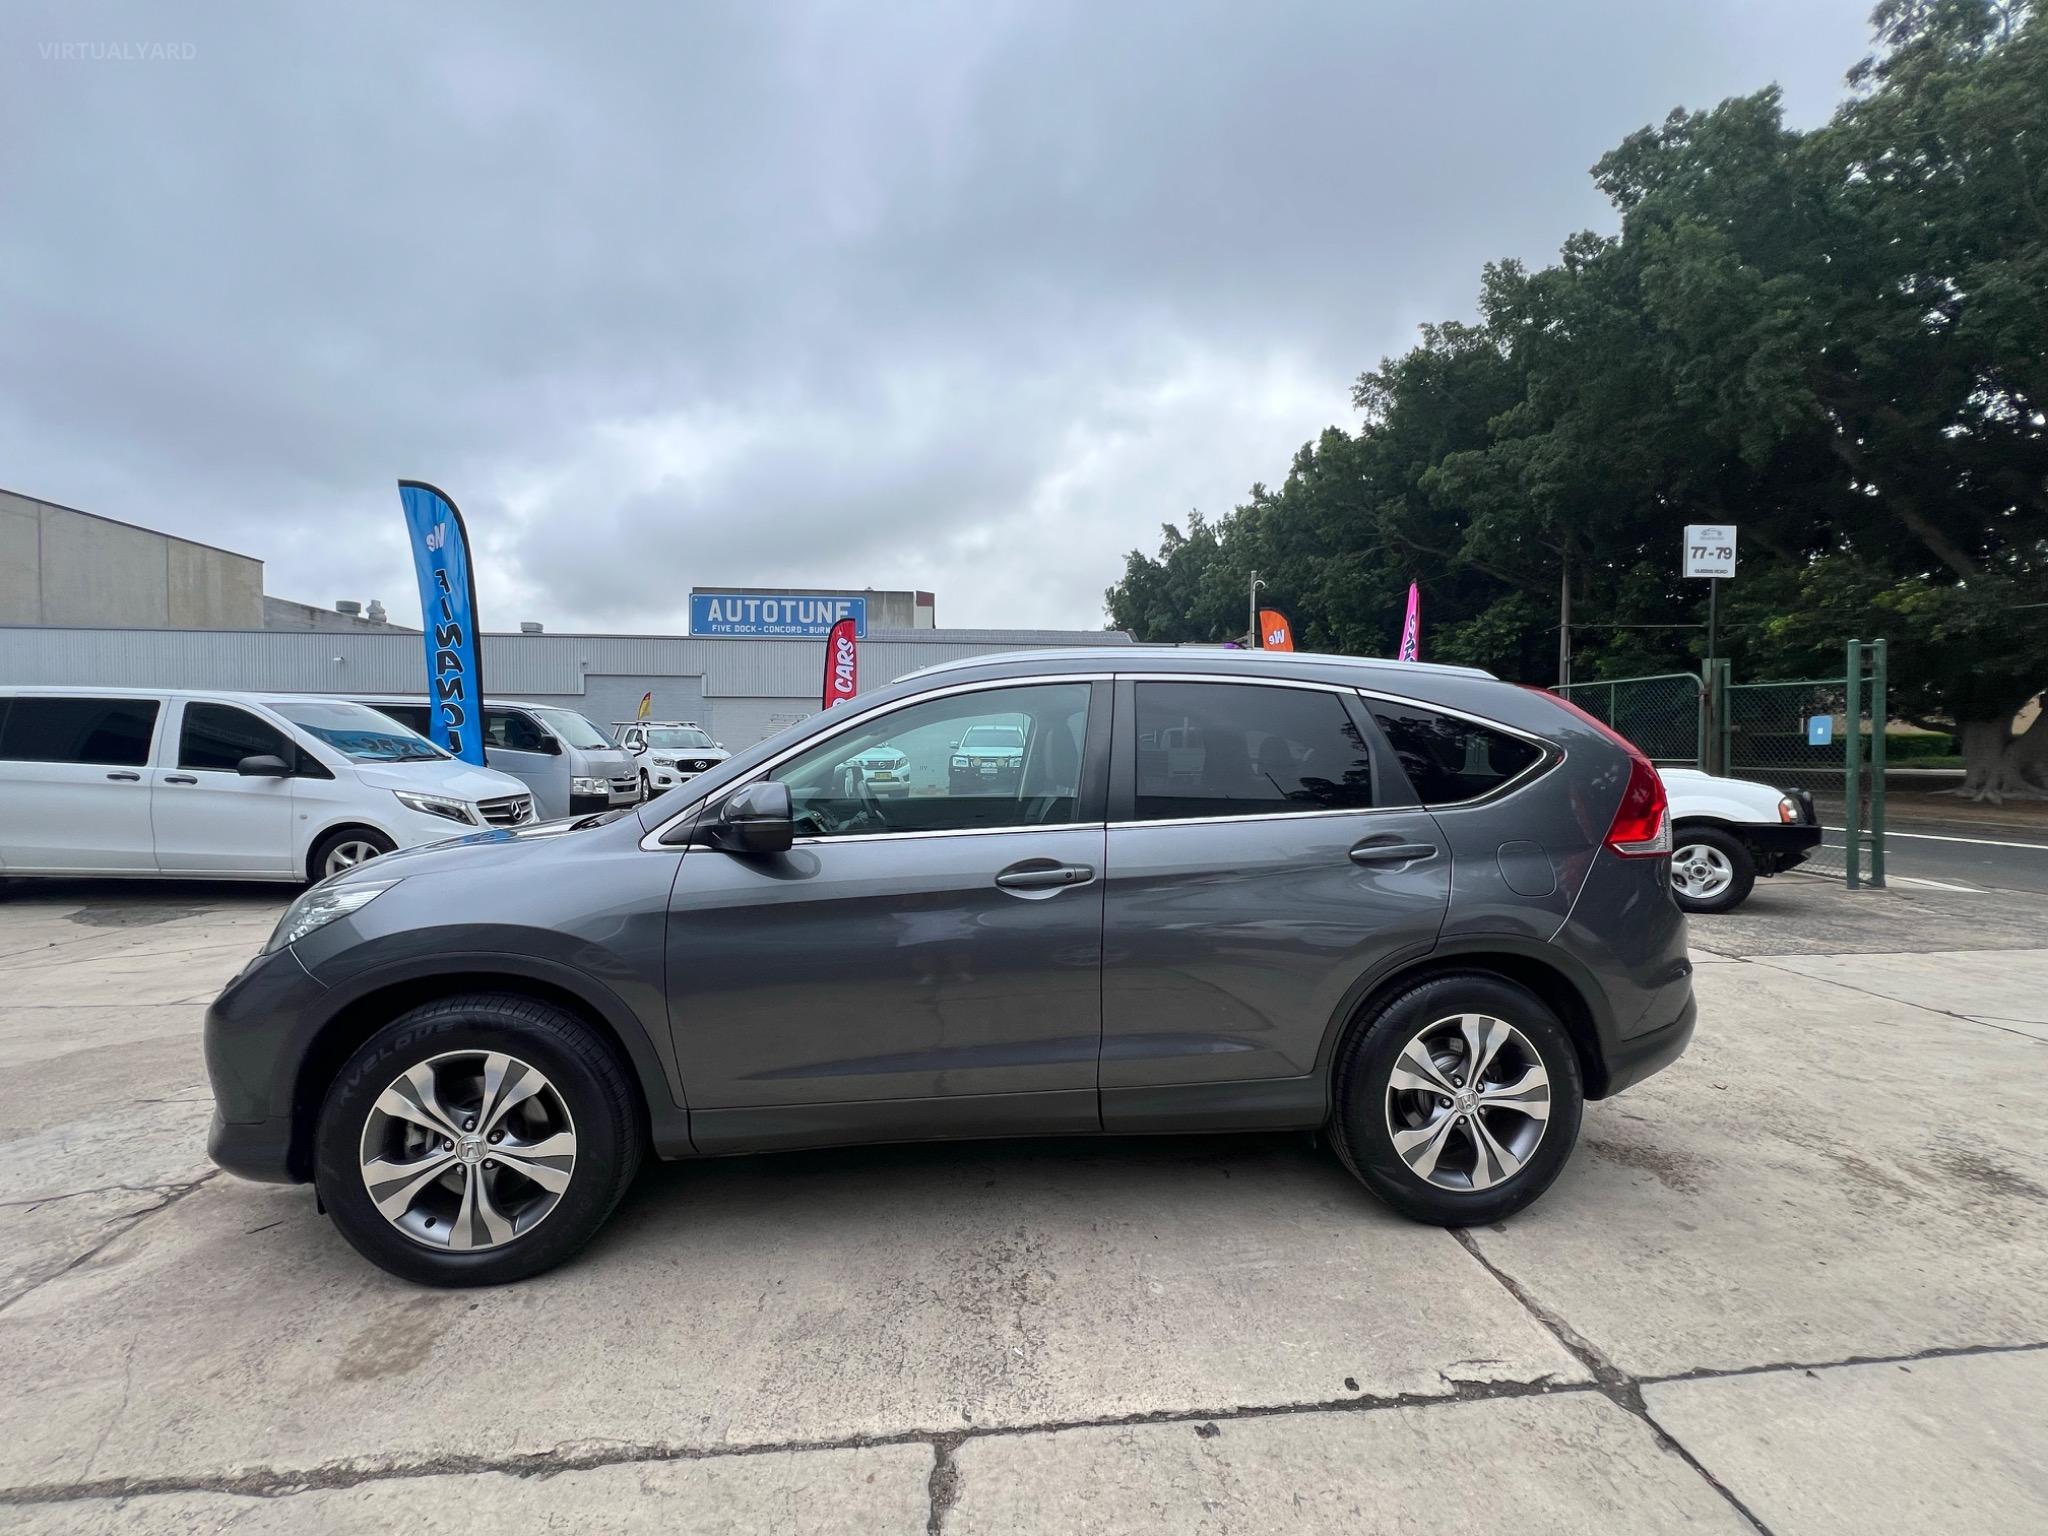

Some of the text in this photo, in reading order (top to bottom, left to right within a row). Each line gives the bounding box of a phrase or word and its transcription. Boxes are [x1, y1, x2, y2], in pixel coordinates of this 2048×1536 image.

[707, 599, 851, 624] AUTOTUNE
[711, 624, 732, 633] FIVE
[734, 624, 757, 633] DOCK
[763, 625, 802, 634] CONCORD
[834, 637, 854, 693] CARS
